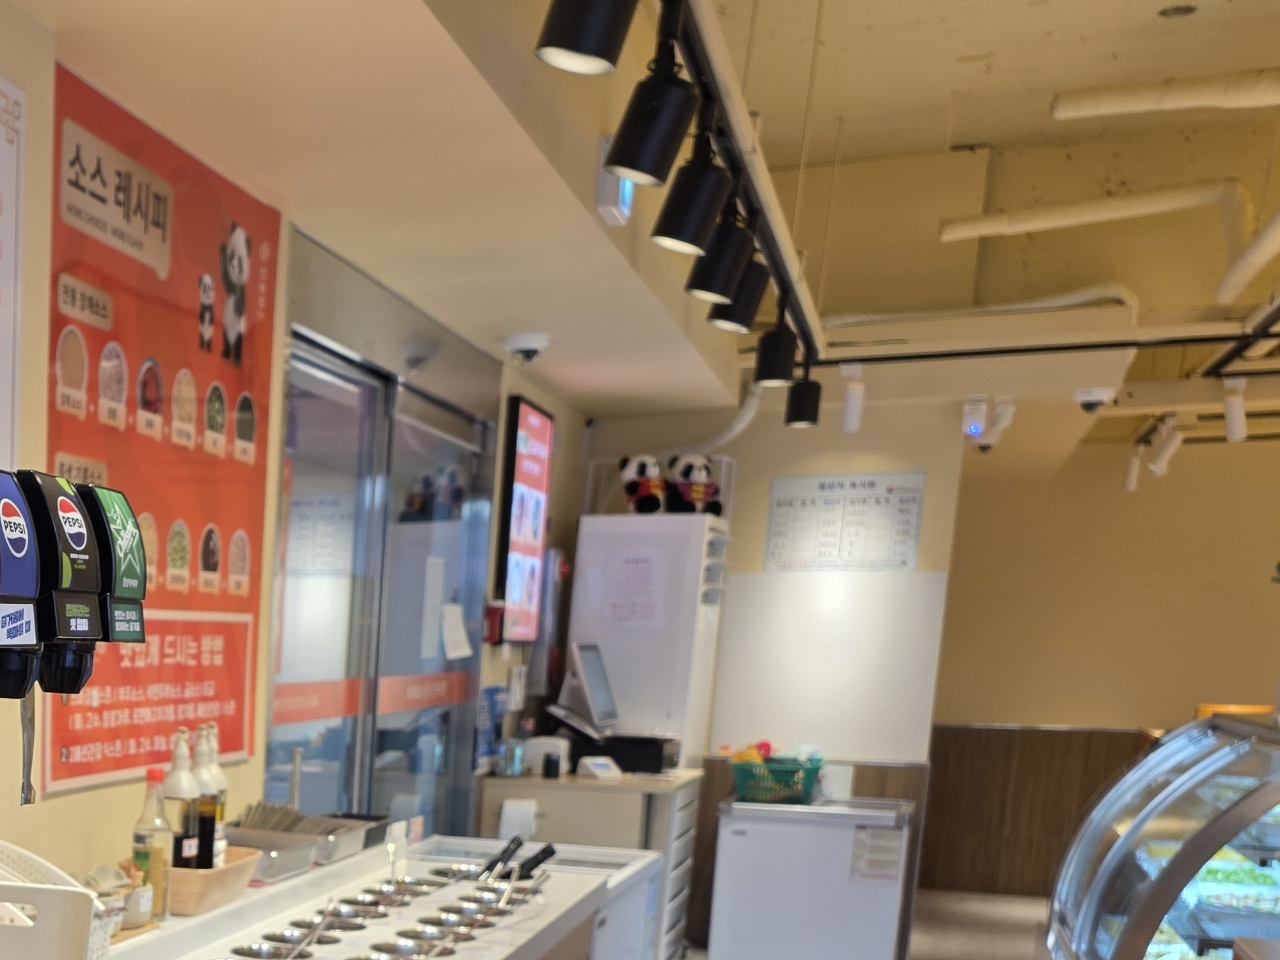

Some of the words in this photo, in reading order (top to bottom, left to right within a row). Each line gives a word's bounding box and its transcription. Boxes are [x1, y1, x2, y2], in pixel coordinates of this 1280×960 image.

[67, 143, 108, 206] 소스
[114, 169, 170, 246] 레시피
[4, 520, 26, 534] PEPSI
[61, 516, 84, 530] PEPSI
